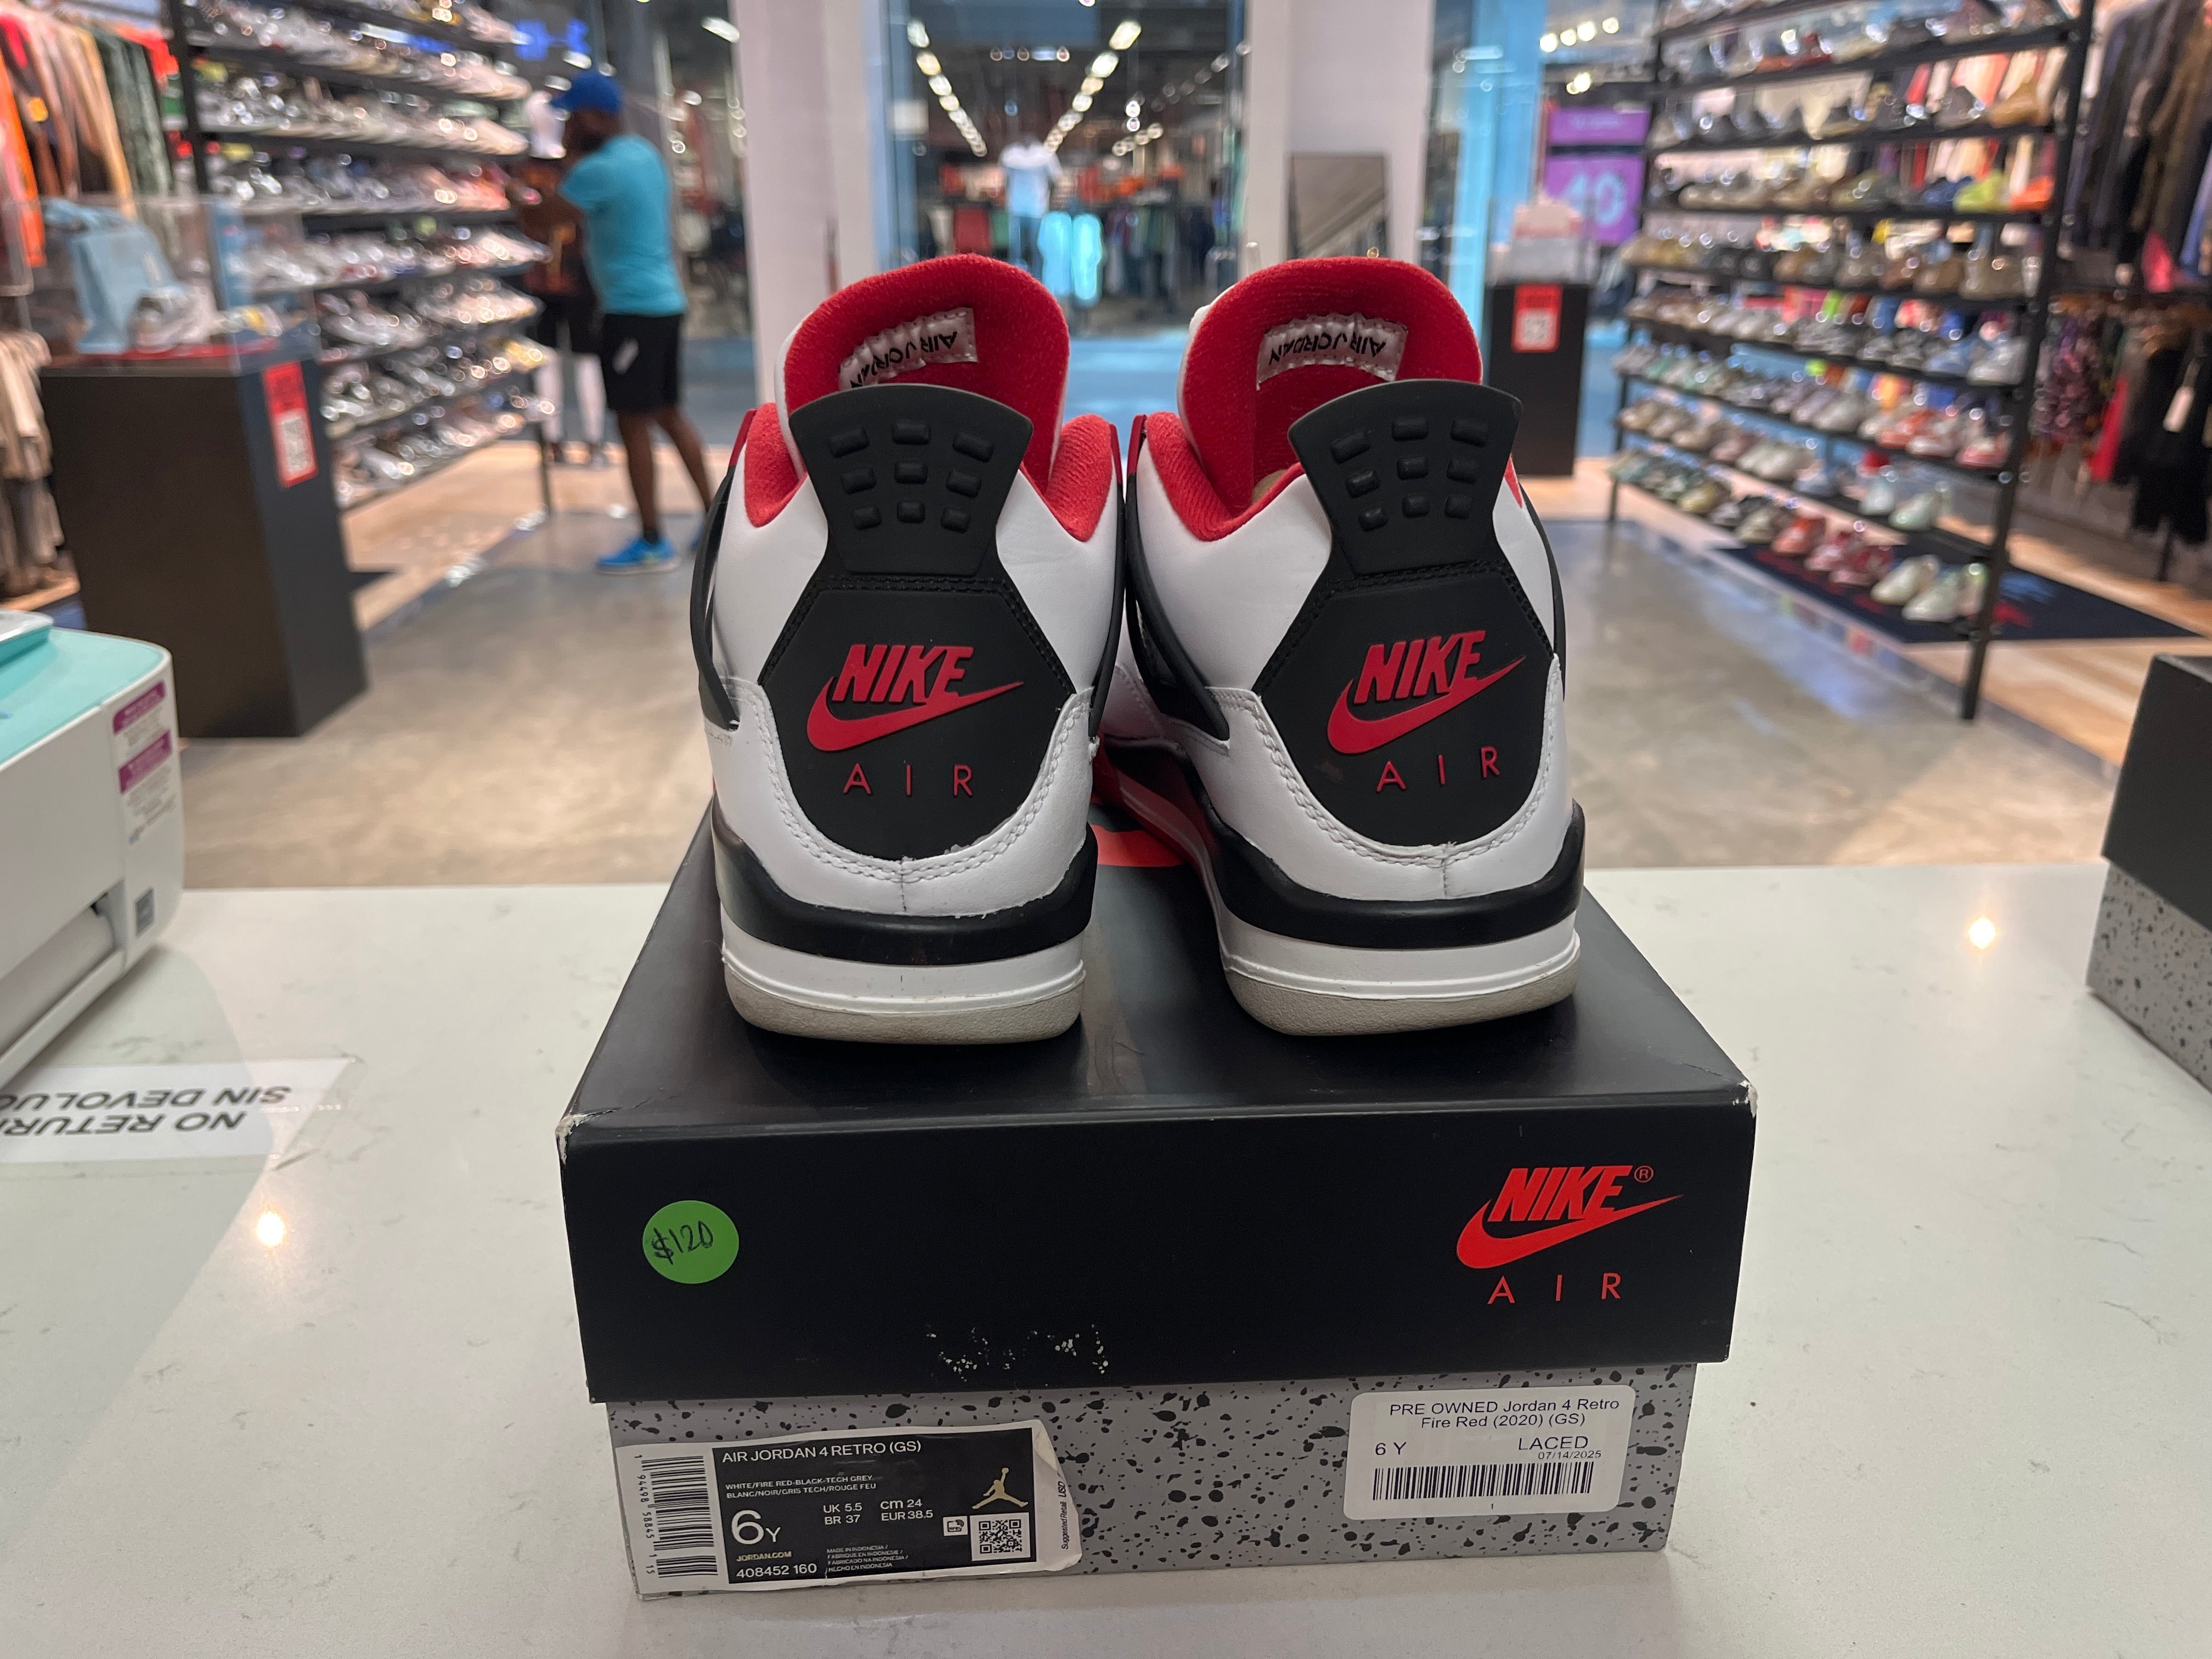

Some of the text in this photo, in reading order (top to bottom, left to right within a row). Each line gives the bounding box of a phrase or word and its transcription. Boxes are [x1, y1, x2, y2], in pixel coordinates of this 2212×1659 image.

[920, 331, 958, 353] AIR
[1268, 331, 1386, 365] AIR JORDAN
[832, 644, 974, 704] NIKE
[1354, 630, 1486, 704] NIKE
[1376, 746, 1500, 793] AIR
[843, 763, 973, 796] AIR
[212, 1086, 291, 1105] SIN
[176, 1111, 248, 1131] NO
[1487, 1165, 1633, 1222] NIKE
[651, 1220, 713, 1265] $120
[1487, 1272, 1622, 1305] AIR
[1390, 1397, 1620, 1416] PRE OWNED Jordan 4 Retro
[1421, 1413, 1585, 1429] Fire Red (2020) (GS)
[722, 1440, 922, 1463] AIR JORDAN 4 RETRO (GS)
[1374, 1441, 1407, 1455] 6 Y
[1518, 1436, 1589, 1451] LACED
[1538, 1450, 1601, 1460] 07/14/2025
[637, 1475, 650, 1503] 94498
[725, 1481, 774, 1490] WHITE/FIRE
[776, 1476, 848, 1487] RED-BLACK-TECH
[727, 1487, 801, 1499] BLANC/NOIR/GRIS
[803, 1484, 858, 1494] TECH/ROUGE
[1058, 1481, 1067, 1498] USD
[823, 1502, 862, 1514] UK 5.5
[881, 1498, 922, 1510] cm 24
[825, 1514, 861, 1525] BR 37
[881, 1509, 933, 1521] EUR 38.5
[642, 1512, 654, 1539] 58845
[1061, 1517, 1070, 1549] Suggested
[736, 1551, 792, 1562] JORDAN.COM
[646, 1565, 655, 1575] 15
[736, 1563, 817, 1578] 408452 160
